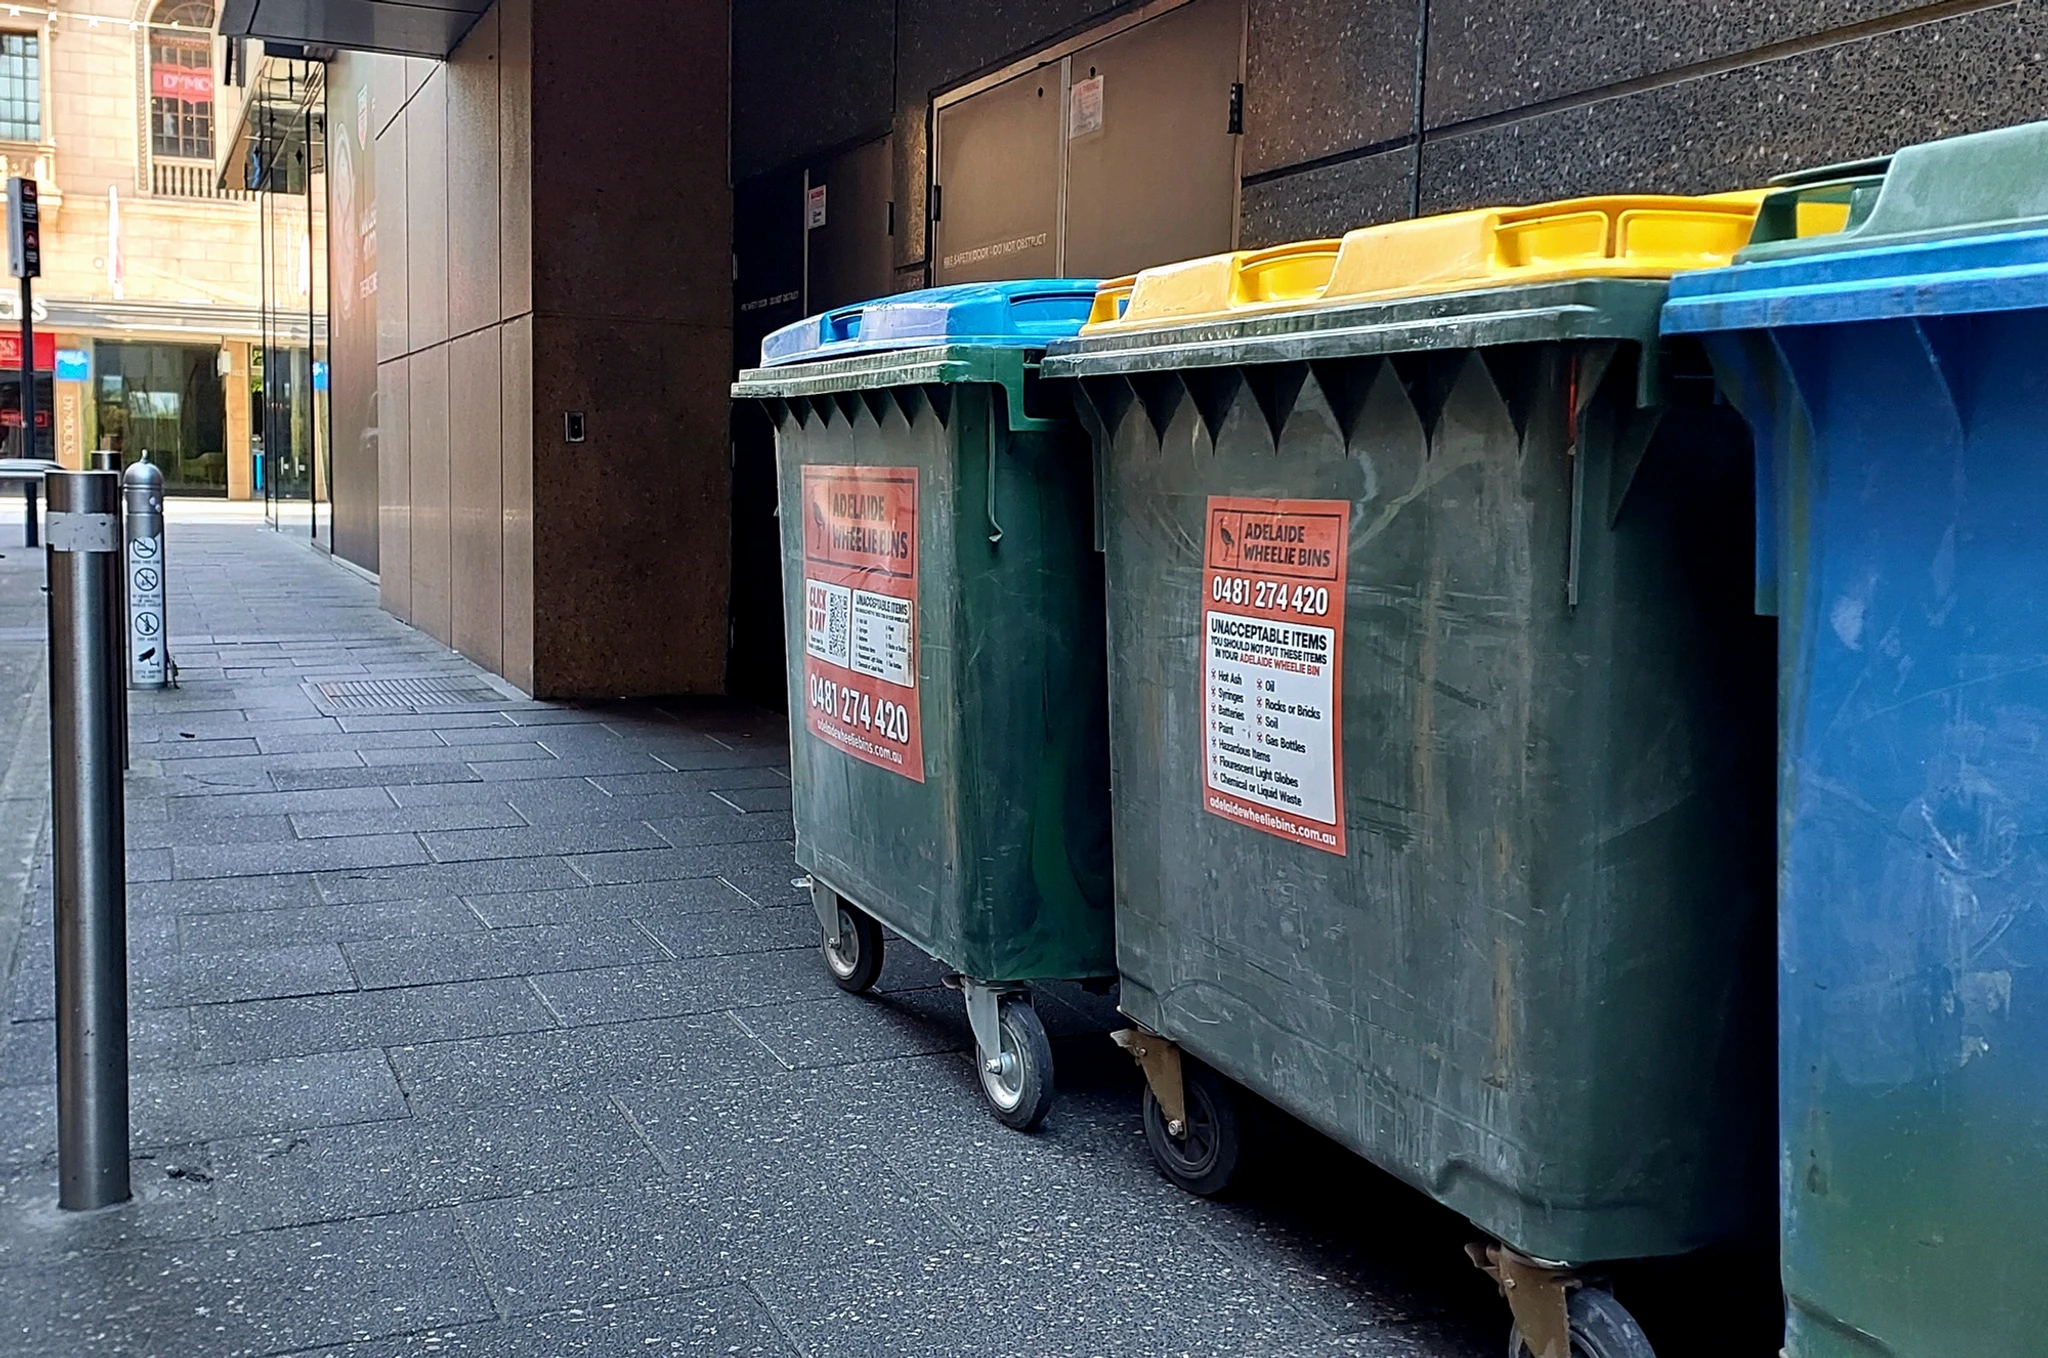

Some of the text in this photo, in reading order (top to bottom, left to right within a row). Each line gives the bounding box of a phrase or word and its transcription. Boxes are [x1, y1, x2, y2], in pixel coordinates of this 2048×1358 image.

[1016, 233, 1047, 250] OBSTRUCT
[833, 493, 885, 522] ADELAIDE
[833, 525, 909, 560] WHEELIE BINS
[1244, 523, 1305, 543] ADELAIDE
[1243, 544, 1331, 568] WHEELIE BINS
[1212, 575, 1329, 616] 0481 274 420
[1211, 618, 1328, 651] UNACCEPTABLE ITEMS
[1211, 636, 1328, 665] YOU SHOULD NOT PUT THESE ITEMS
[1215, 648, 1321, 677] IN YOUR ADELAIDE WHEELIE BIN
[1218, 669, 1242, 686] Hot Ash
[1265, 679, 1275, 693] Oil
[1218, 688, 1244, 704] Syringes
[810, 673, 909, 744] 0481 274 420
[1218, 704, 1245, 721] Batteries
[1265, 698, 1321, 720] Rocks or Bricks
[1218, 721, 1234, 736] Paint
[1265, 716, 1279, 730] Soil
[817, 718, 904, 765] adelaidewheeliebins.com.au
[1265, 733, 1306, 754] Gas Bottles
[1252, 747, 1271, 763] Items
[1255, 765, 1273, 782] Light
[1274, 770, 1299, 788] Globes
[1219, 772, 1303, 807] Chemical or Liquid Waste
[1209, 796, 1337, 846] adelaidewheeliebins.com.au
